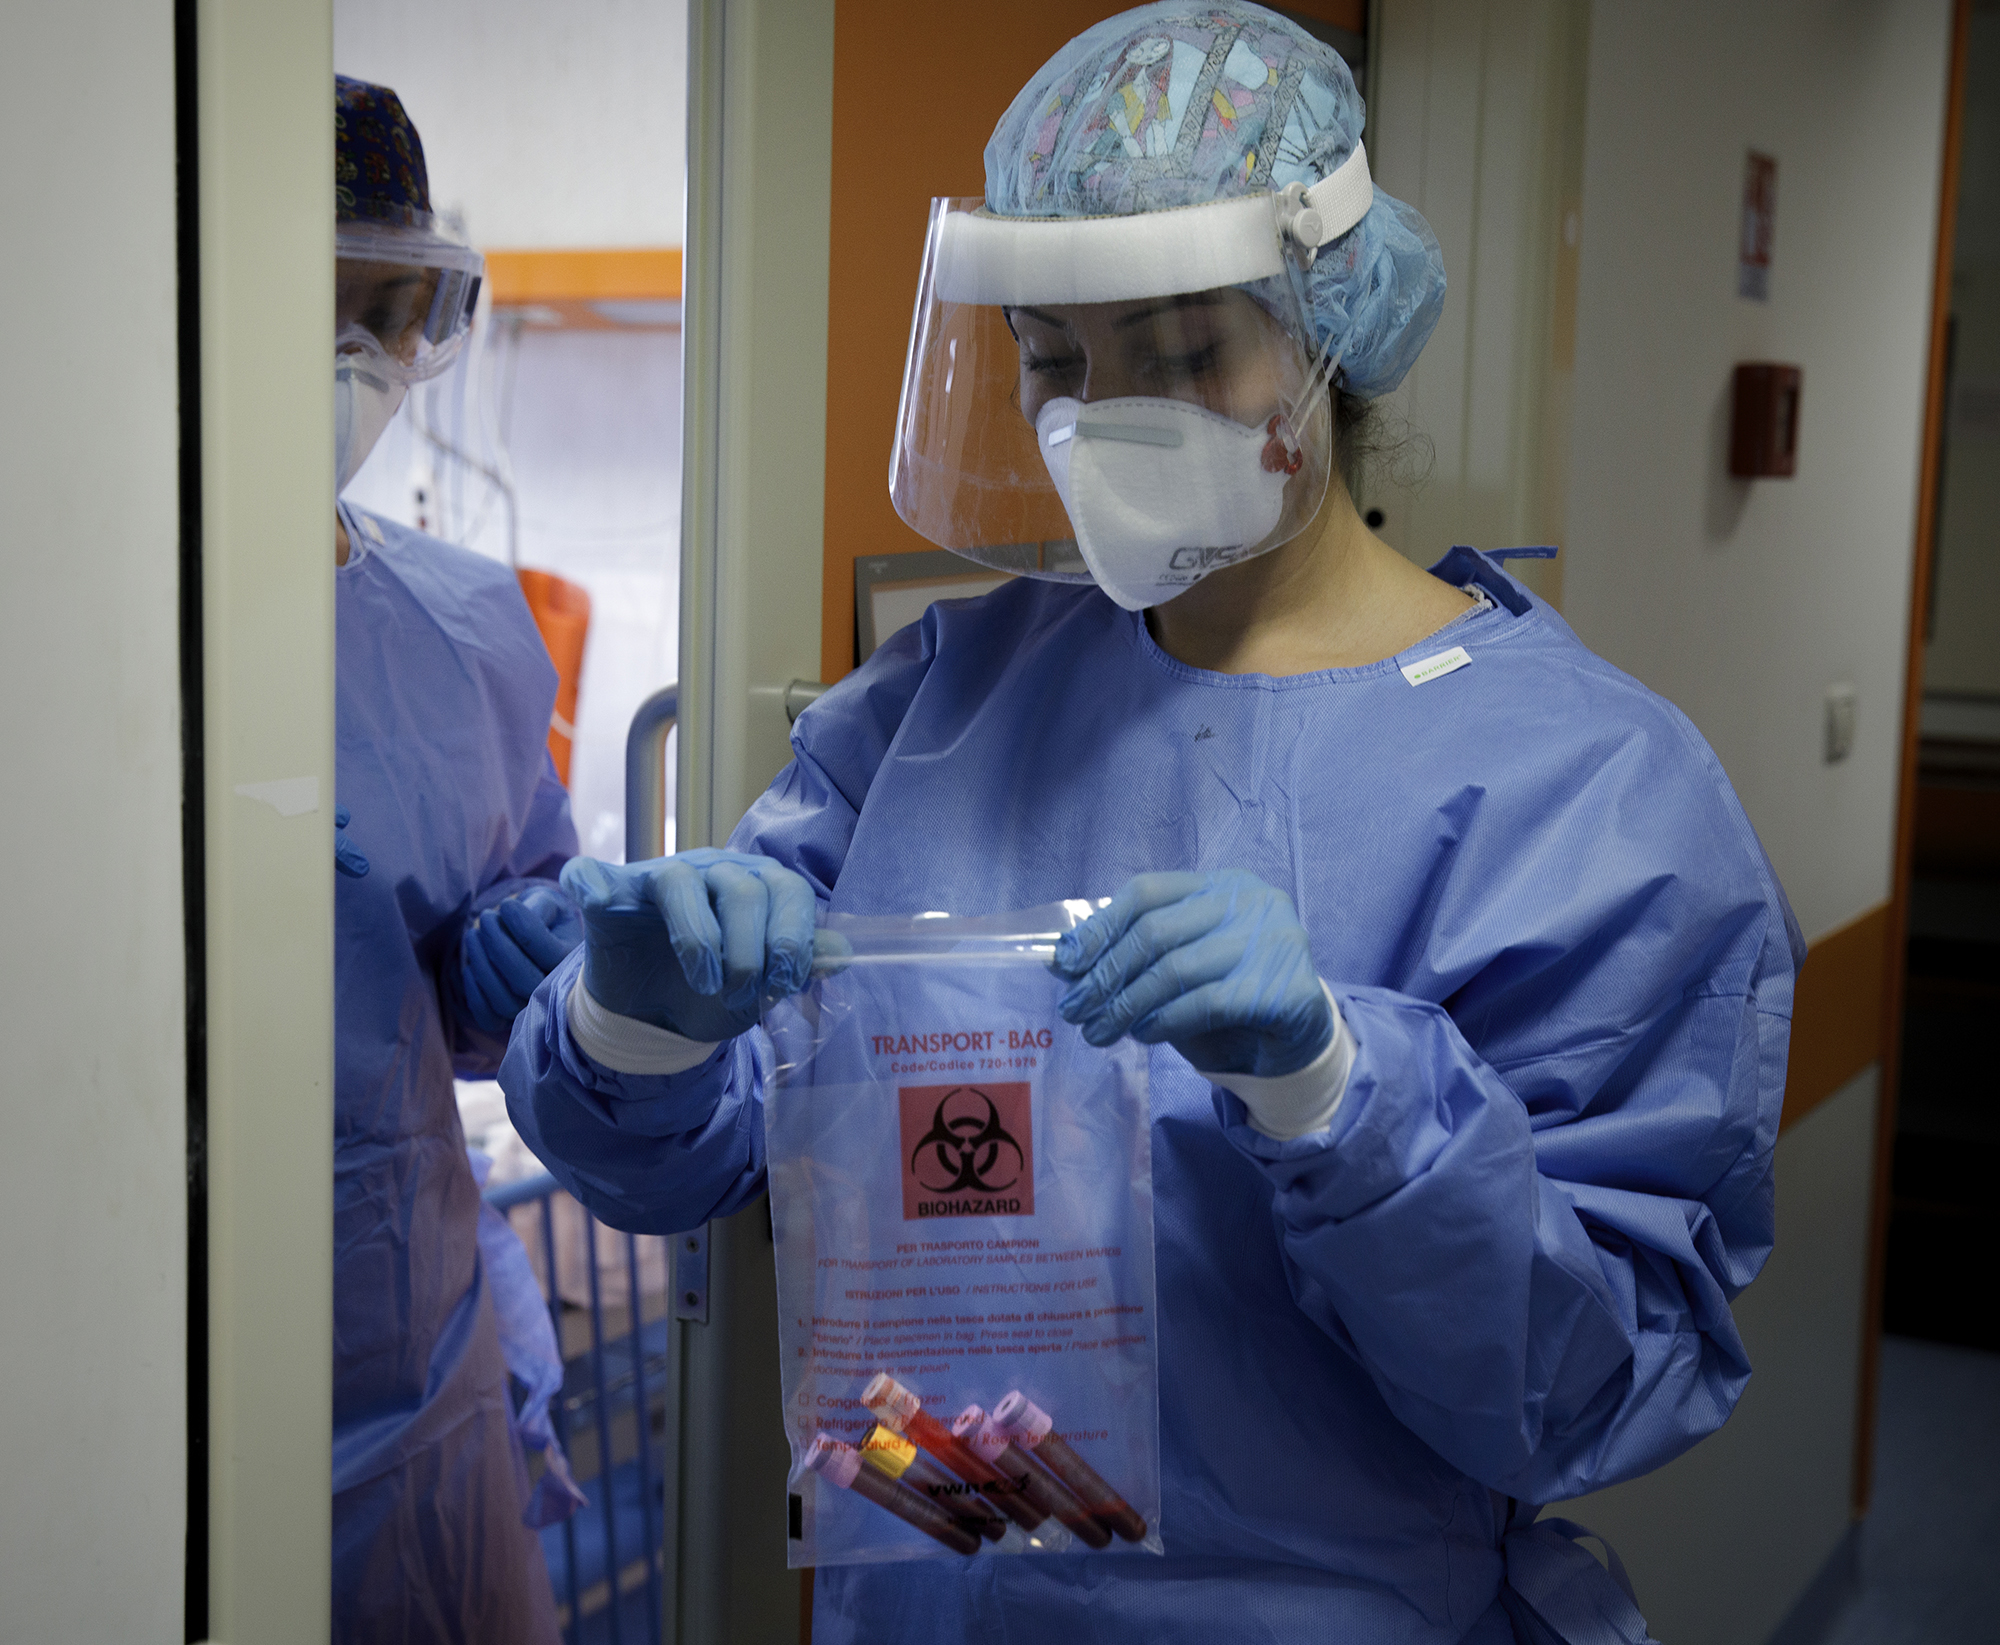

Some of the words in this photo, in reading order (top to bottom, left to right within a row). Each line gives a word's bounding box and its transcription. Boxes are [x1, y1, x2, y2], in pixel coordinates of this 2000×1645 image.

[1421, 656, 1461, 677] BARRIER
[871, 1032, 994, 1055] TRANSPORT
[1008, 1028, 1054, 1049] BAG
[891, 1059, 975, 1073] Code/Codice
[918, 1198, 1021, 1218] BIOHAZARD
[896, 1243, 918, 1254] PER
[921, 1240, 984, 1252] TRASPORTO
[986, 1238, 1040, 1250] CAMPIONI
[817, 1258, 838, 1268] FOR
[841, 1258, 898, 1271] TRANSPORT
[900, 1257, 914, 1269] OF
[917, 1254, 984, 1268] LABORATORY
[986, 1253, 1033, 1265] SAMPLES
[1035, 1250, 1084, 1264] BETWEEN
[1085, 1247, 1121, 1258] WARDS
[845, 1288, 903, 1300] ISTRUZIONI
[905, 1285, 927, 1297] PER
[929, 1284, 960, 1296] L'USO
[972, 1282, 1051, 1295] INSTRUCTIONS
[1053, 1279, 1076, 1292] FOR
[1077, 1276, 1098, 1290] USE
[872, 1317, 925, 1330] campione
[927, 1315, 952, 1325] nella
[955, 1314, 984, 1325] tasca
[1024, 1311, 1034, 1323] di
[1037, 1310, 1082, 1322] chiusura
